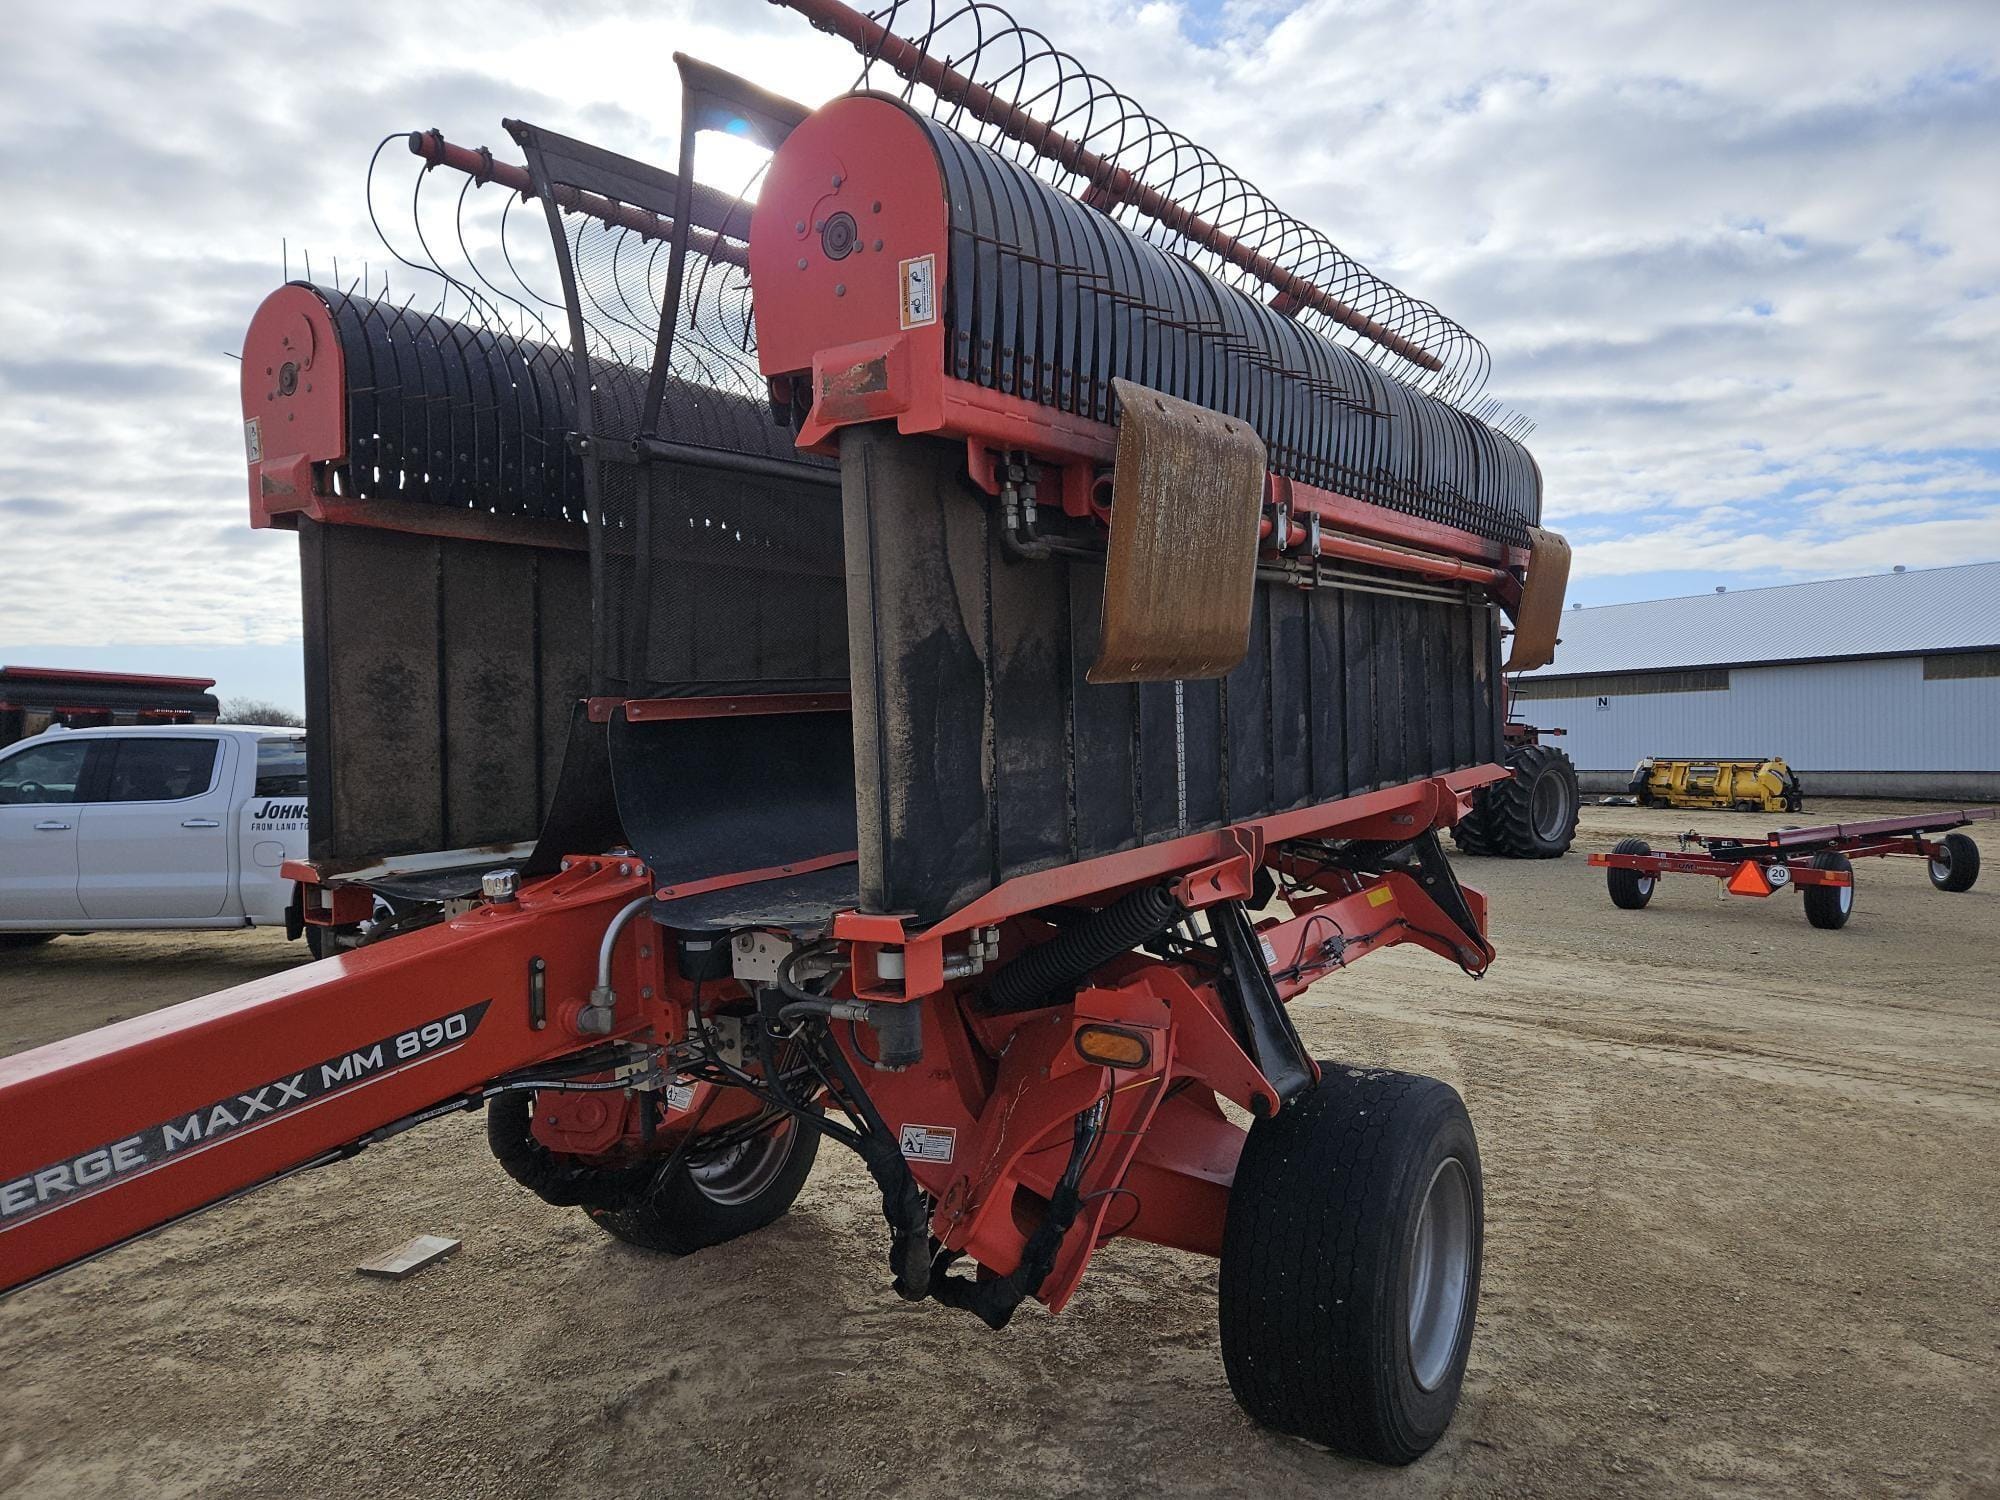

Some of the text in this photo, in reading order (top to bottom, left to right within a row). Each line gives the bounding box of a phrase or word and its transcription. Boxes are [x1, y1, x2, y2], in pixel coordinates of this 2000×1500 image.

[1598, 697, 1608, 706] N
[251, 823, 273, 831] FROM
[276, 823, 296, 831] LAND
[1772, 869, 1785, 877] 20
[162, 1073, 308, 1151] MAXX
[321, 1045, 384, 1089] MM
[395, 1014, 467, 1059] 890
